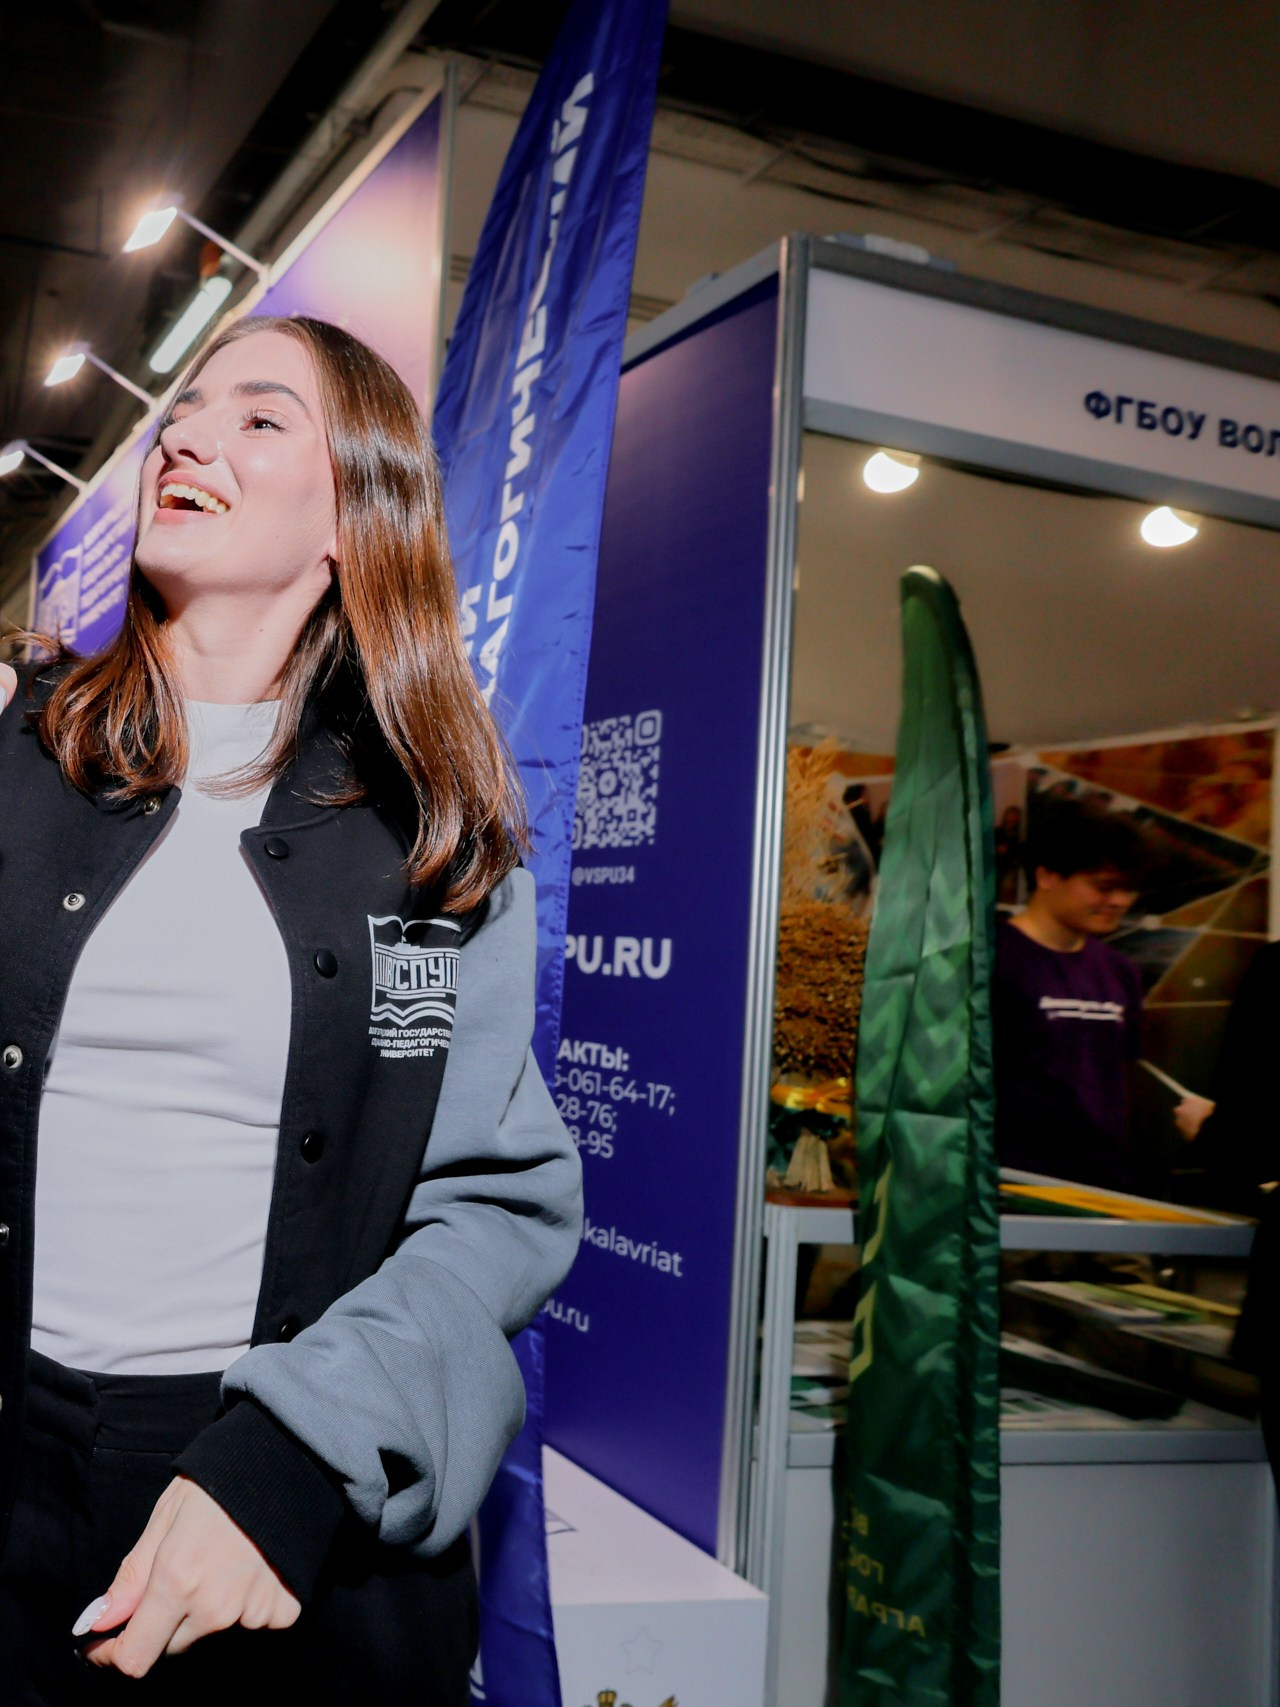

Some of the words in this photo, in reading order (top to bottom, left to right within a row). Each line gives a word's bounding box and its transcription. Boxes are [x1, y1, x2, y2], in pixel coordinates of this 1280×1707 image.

[1084, 390, 1207, 440] ФГБОУ
[571, 866, 635, 886] @VSPU34
[557, 1038, 629, 1072] АКТЫ:
[582, 1217, 683, 1278] kalavriat
